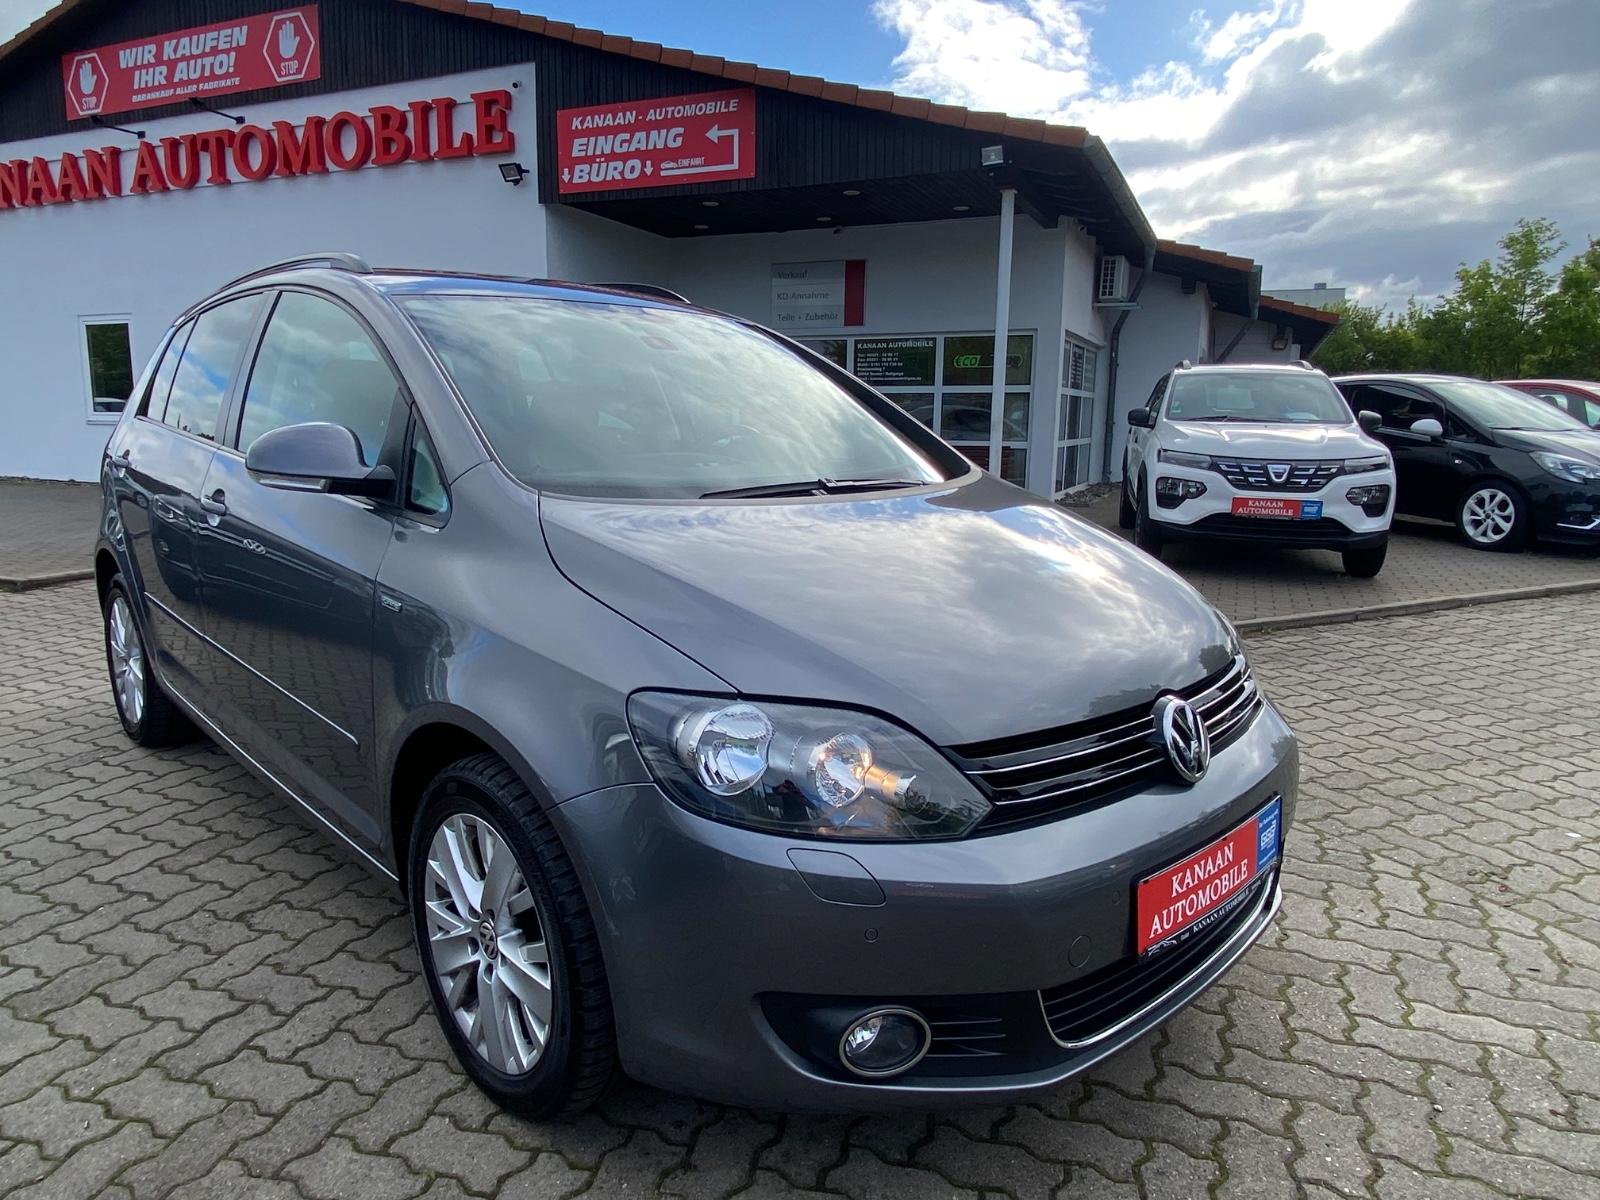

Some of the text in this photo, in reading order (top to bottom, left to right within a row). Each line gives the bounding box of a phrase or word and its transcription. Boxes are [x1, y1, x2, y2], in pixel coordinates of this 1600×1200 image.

[119, 25, 248, 69] WIR KAUFEN
[133, 51, 236, 90] IHR AUTO!
[280, 60, 299, 76] STOP
[132, 77, 241, 103] BARANKAUF ALLER FABRIKATE
[82, 96, 97, 111] STOP
[571, 110, 636, 130] KANAAN
[645, 98, 739, 122] AUTOMOBILE
[130, 88, 516, 194] AUTOMOBILE
[571, 127, 685, 158] EINGANG
[572, 157, 642, 184] BÜRO
[777, 269, 808, 280] Verkauf
[777, 313, 796, 322] Teile
[888, 340, 934, 348] AUTOMOBILE
[1237, 506, 1294, 516] AUTOMOBILE
[1248, 499, 1284, 508] KANAAN
[1170, 842, 1234, 898] KANAAN
[1149, 859, 1249, 940] AUTOMOBILE
